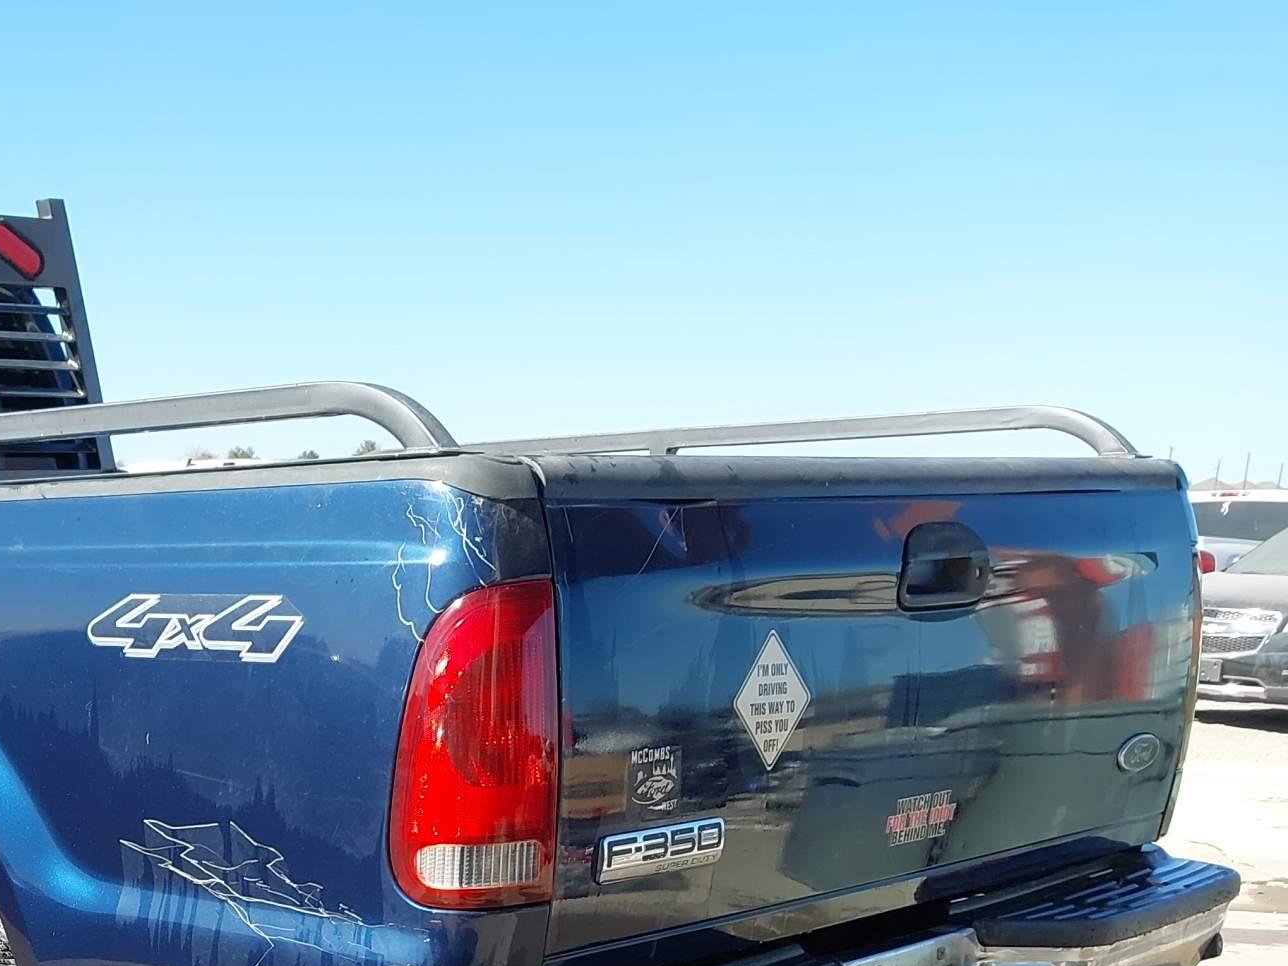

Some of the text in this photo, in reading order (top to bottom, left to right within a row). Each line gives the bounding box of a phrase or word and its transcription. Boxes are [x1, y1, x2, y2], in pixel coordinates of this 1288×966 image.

[87, 593, 304, 663] 4x4
[757, 662, 789, 677] I'M ONLY
[758, 681, 788, 696] DRIVING
[750, 700, 795, 716] THIS WAY TO
[755, 718, 789, 735] PISS YOU
[763, 738, 779, 753] OFF!
[898, 791, 952, 813] WATCH OUT
[908, 810, 928, 828] THE
[891, 825, 928, 846] BEHIND
[654, 853, 718, 873] SUPER DUTY
